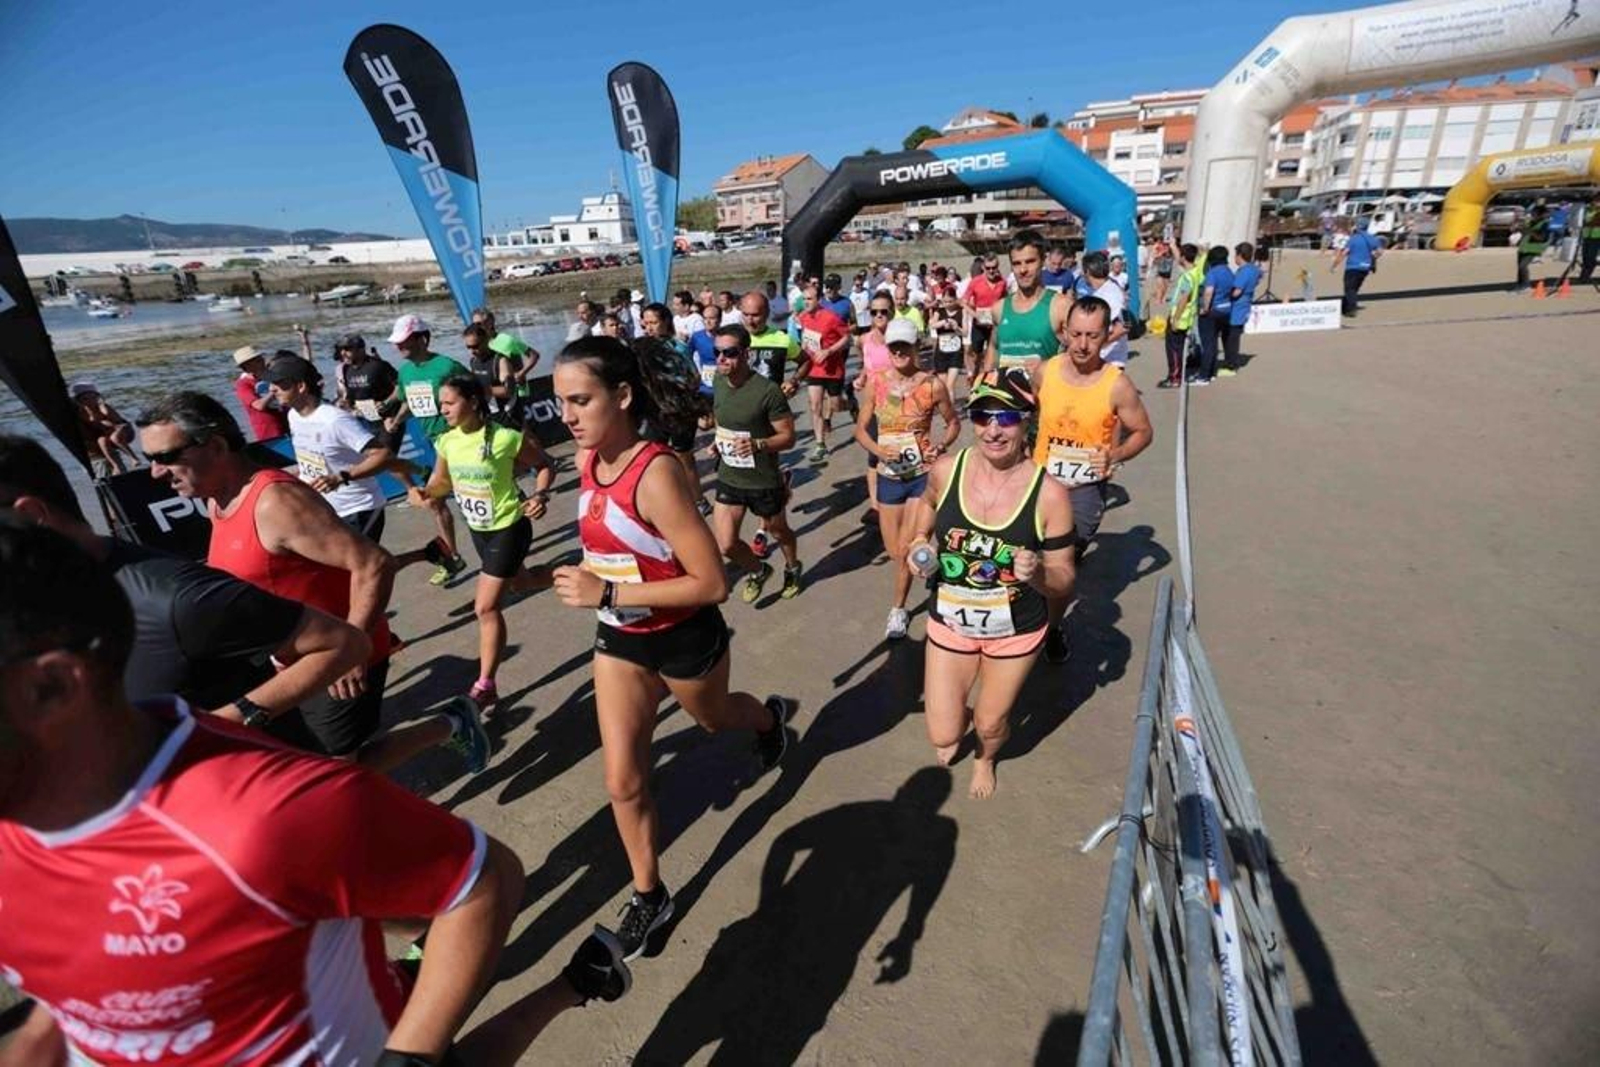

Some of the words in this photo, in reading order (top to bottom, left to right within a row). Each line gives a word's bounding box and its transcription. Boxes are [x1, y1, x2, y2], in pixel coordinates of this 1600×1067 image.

[880, 152, 1008, 186] POWERADE
[1053, 461, 1098, 479] 174
[954, 606, 993, 627] 17
[103, 932, 186, 956] MAYO
